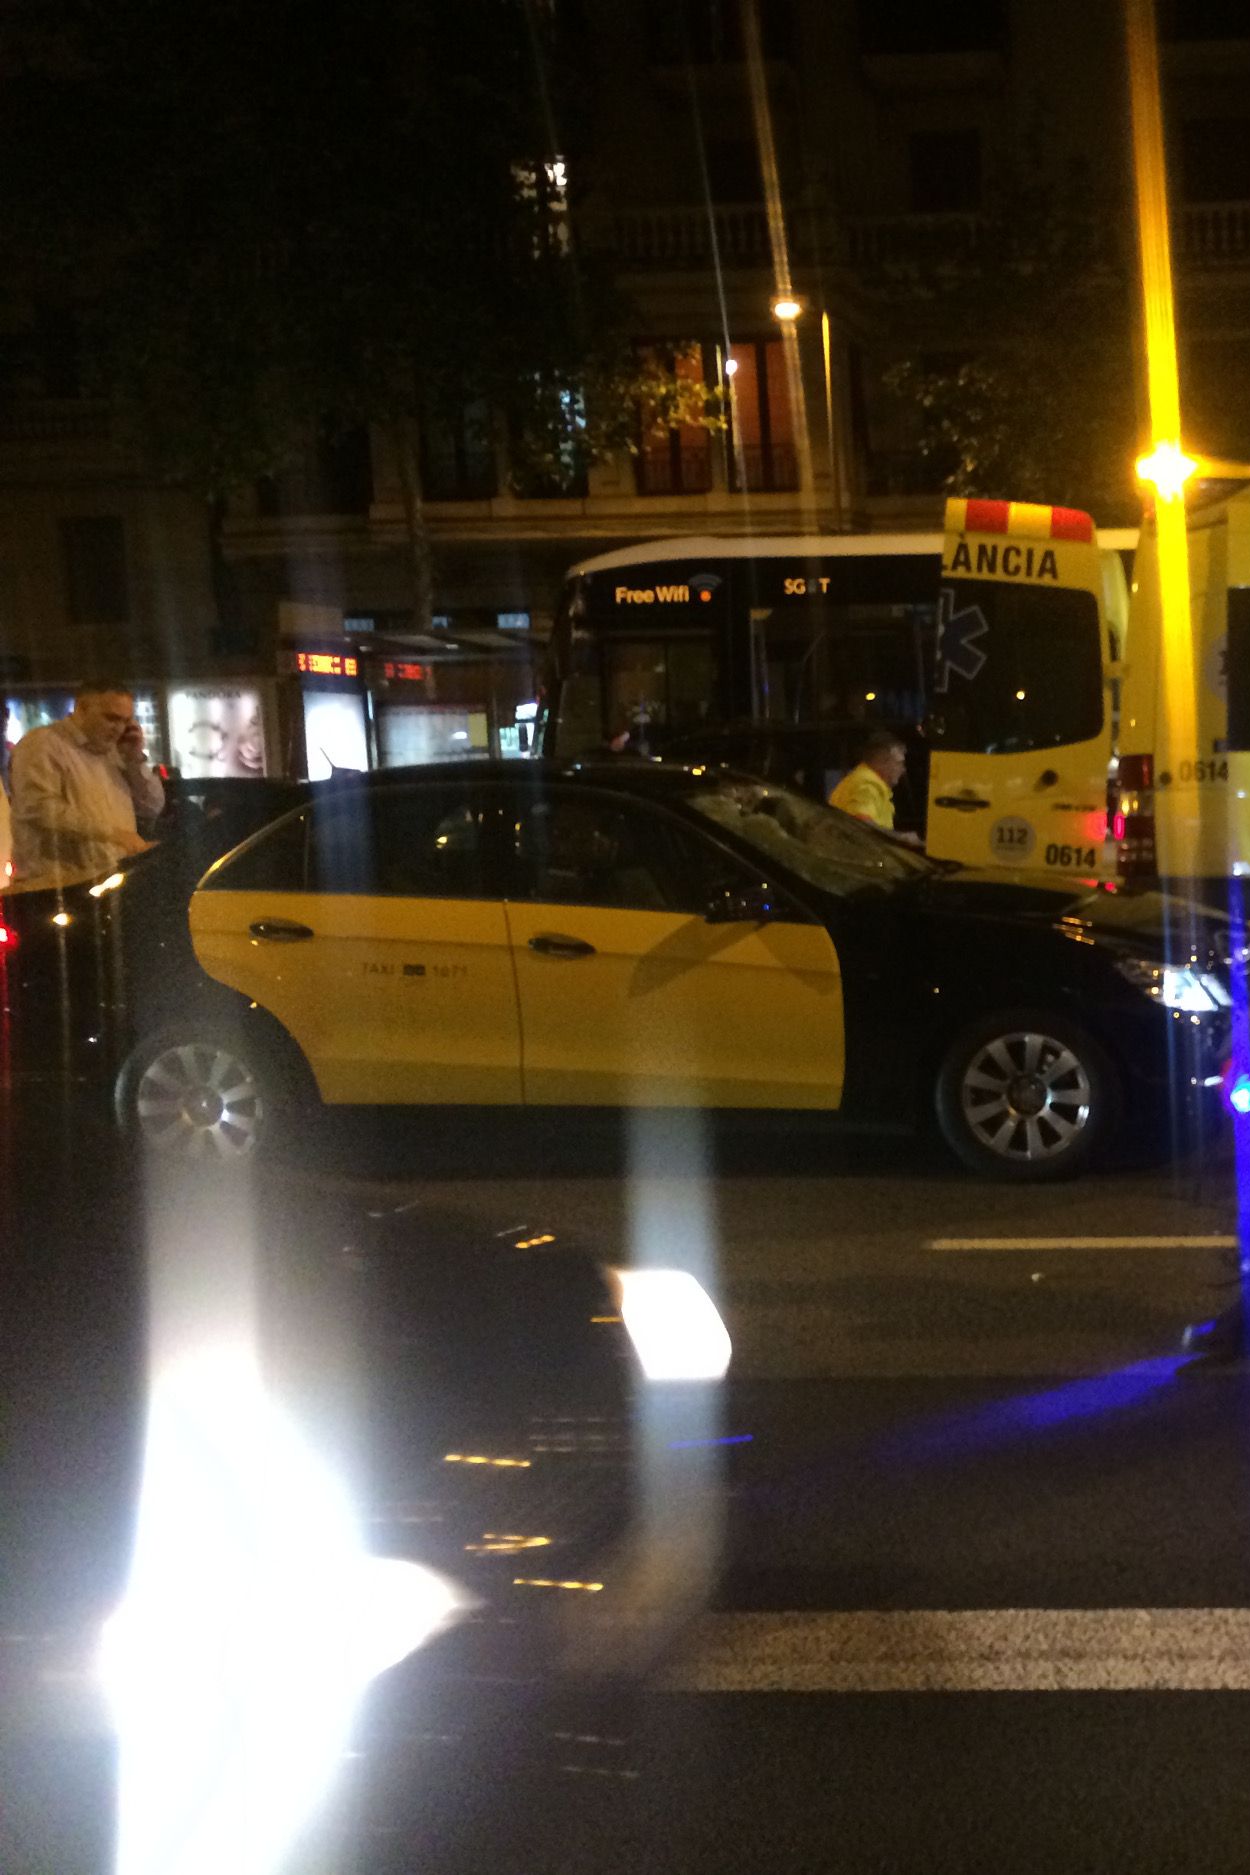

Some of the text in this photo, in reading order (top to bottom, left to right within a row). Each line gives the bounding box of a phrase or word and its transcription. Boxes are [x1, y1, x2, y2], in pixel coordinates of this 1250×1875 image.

[943, 533, 1058, 580] ÀNCIA
[614, 585, 690, 604] Free Wifi
[997, 828, 1028, 845] 112
[1045, 844, 1096, 868] 0614
